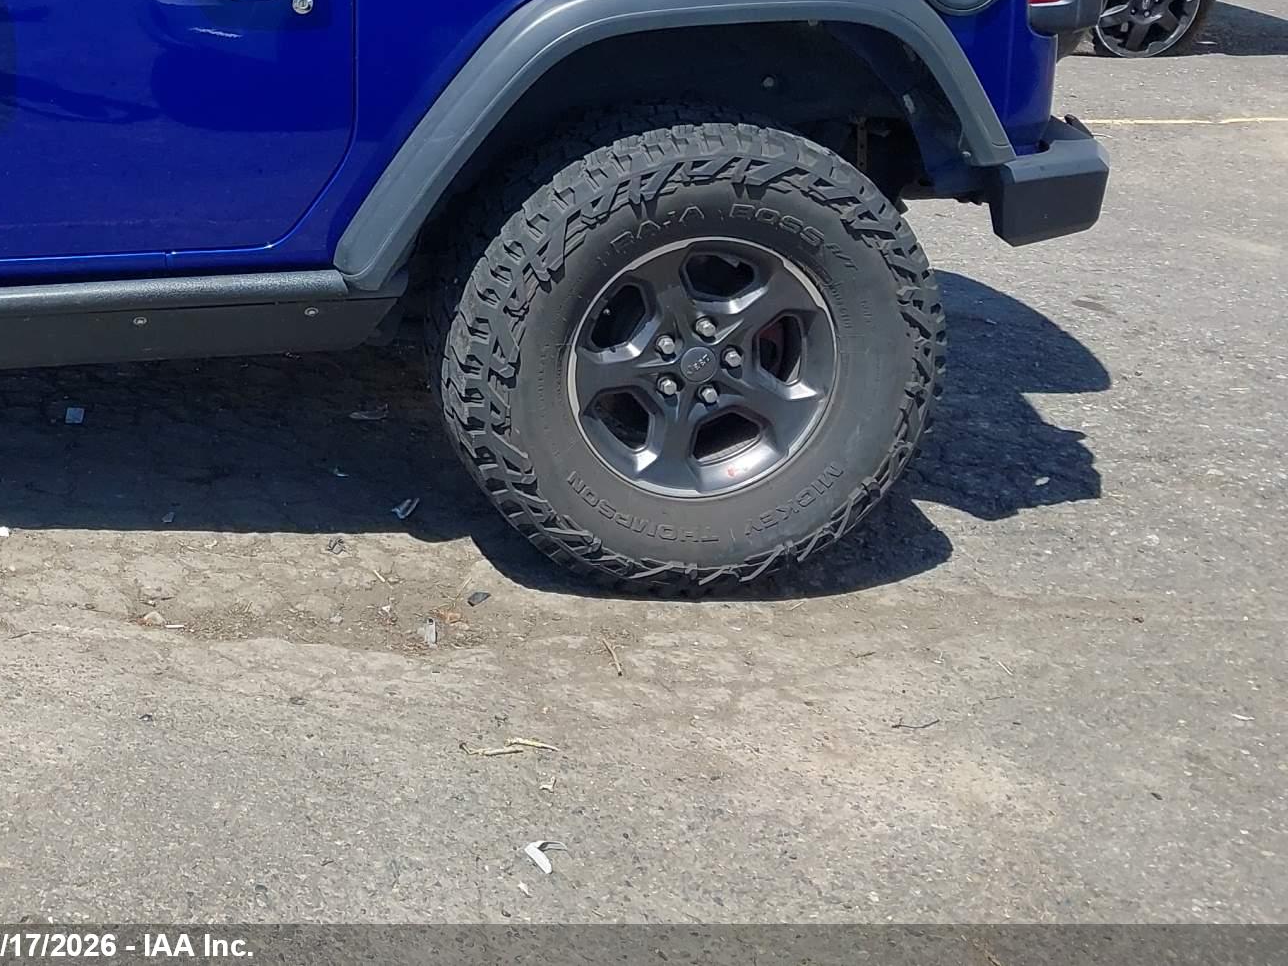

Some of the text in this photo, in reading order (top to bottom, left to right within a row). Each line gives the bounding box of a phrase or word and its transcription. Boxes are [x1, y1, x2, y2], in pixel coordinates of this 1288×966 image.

[728, 203, 825, 248] BOSS
[567, 461, 845, 545] MICKEY THOMPSON
